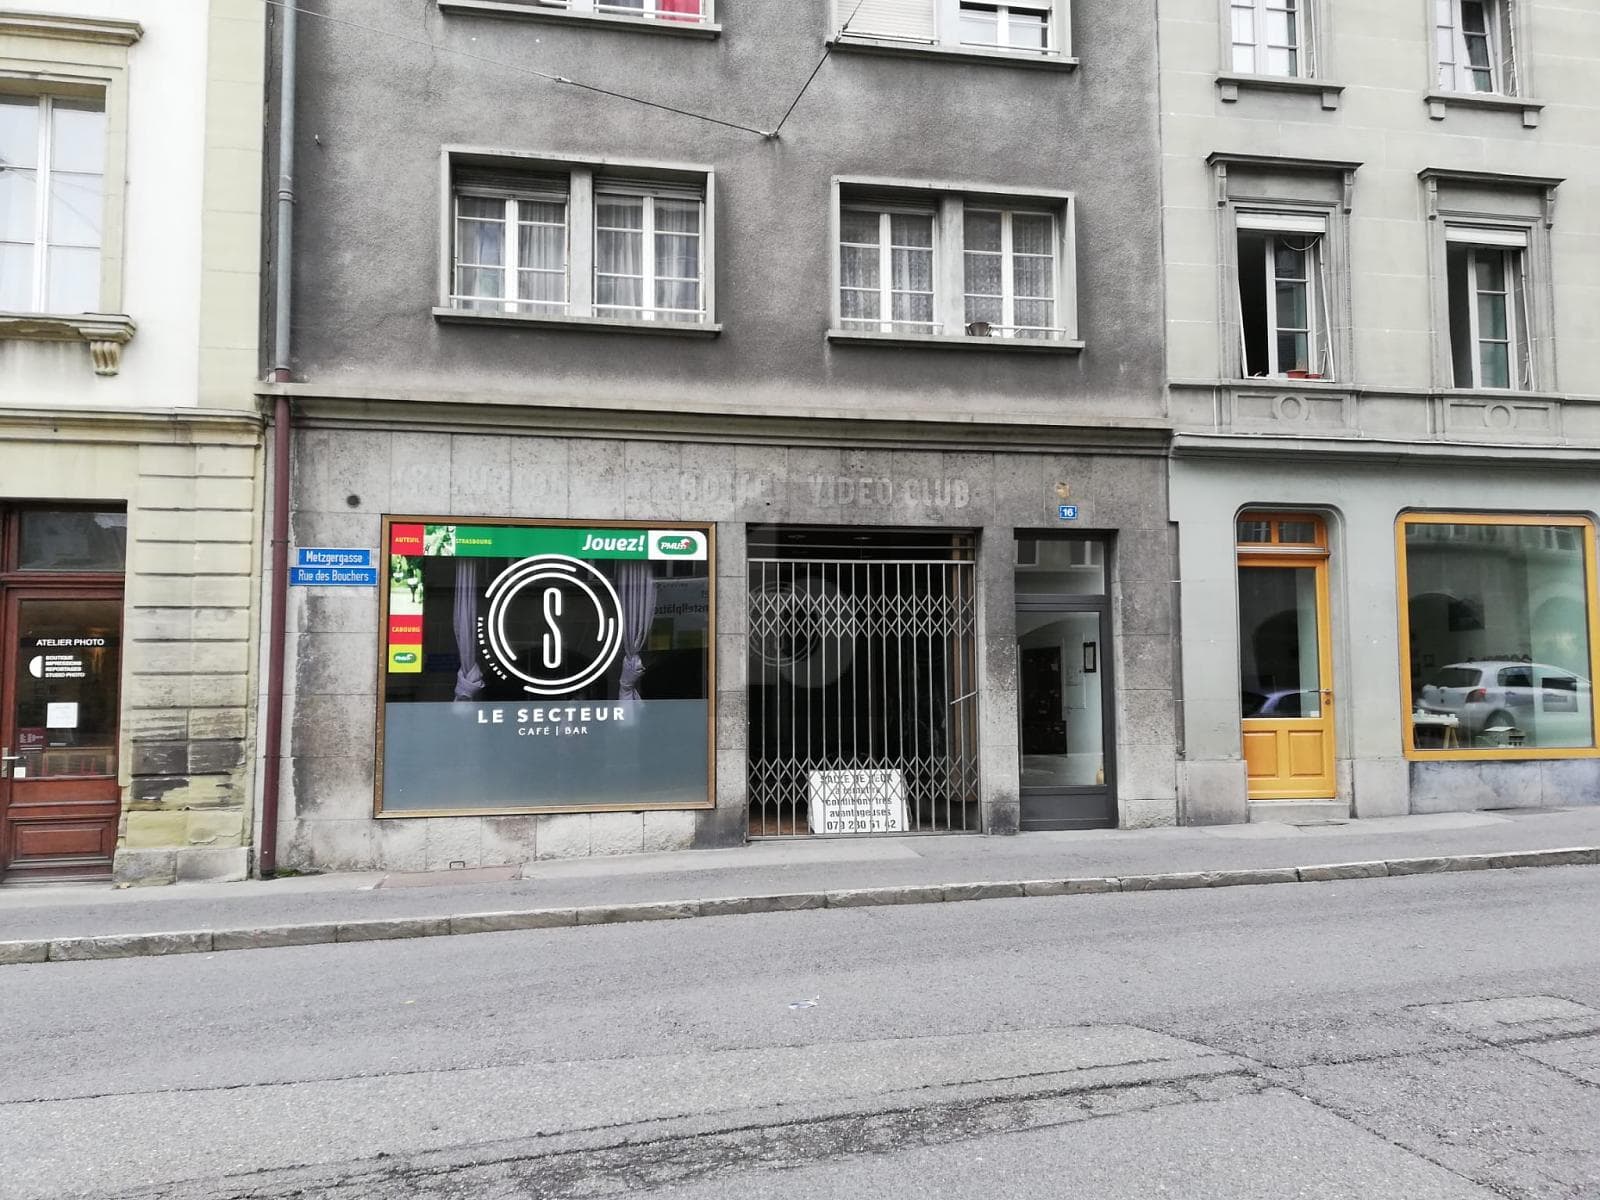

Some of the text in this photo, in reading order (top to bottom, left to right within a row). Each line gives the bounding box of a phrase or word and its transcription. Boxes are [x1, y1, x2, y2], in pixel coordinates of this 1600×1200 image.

[809, 474, 893, 507] VIDEO
[904, 477, 971, 509] CLUB
[1062, 508, 1074, 517] 16
[582, 534, 646, 552] Jouez!
[306, 550, 363, 566] Metzgergasse
[298, 569, 369, 581] Rue des Bouchers
[36, 638, 105, 646] ATELIER PHOTO
[478, 707, 625, 723] LE SECTEUR
[518, 726, 588, 736] CAFÉ BAR
